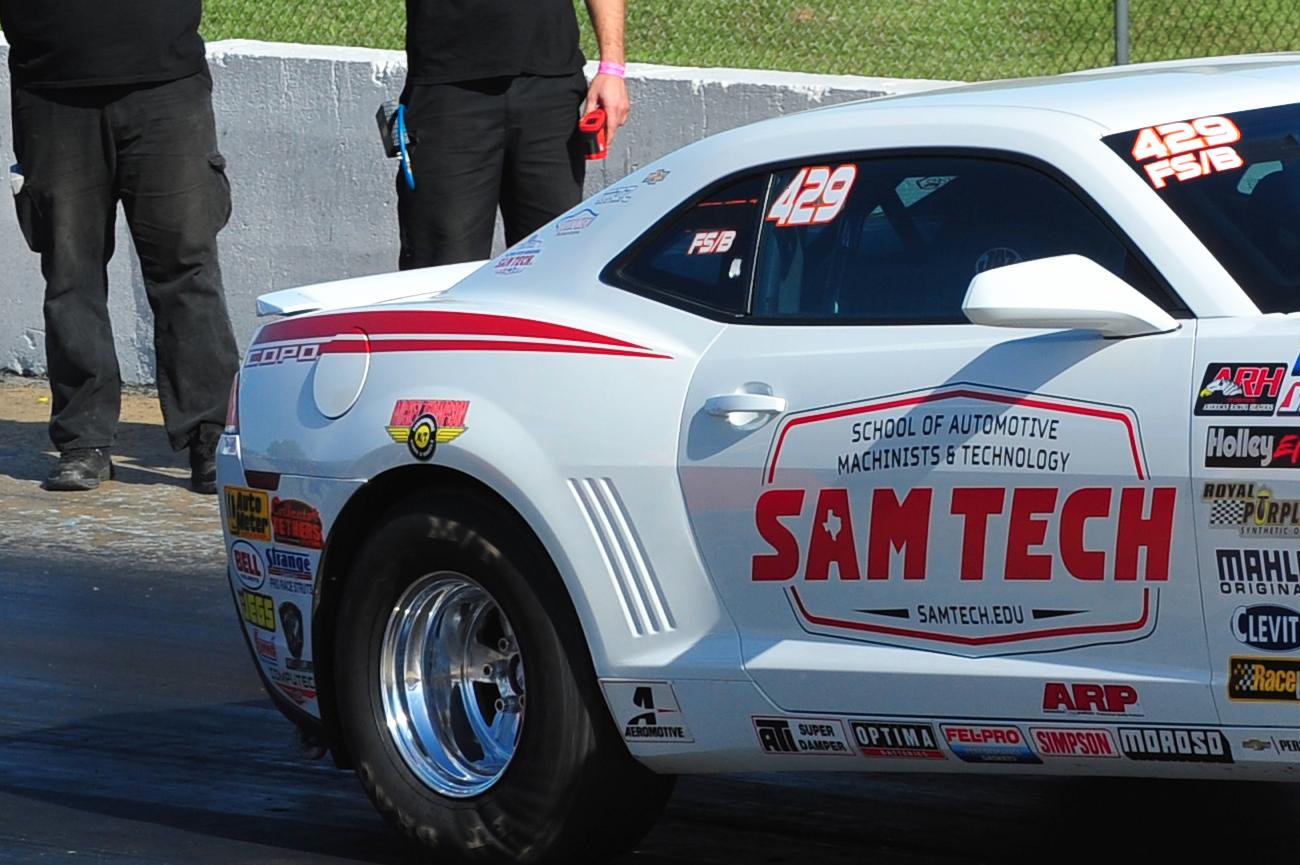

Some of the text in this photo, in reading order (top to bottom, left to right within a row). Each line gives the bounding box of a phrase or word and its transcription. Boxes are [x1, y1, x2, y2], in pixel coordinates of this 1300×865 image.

[1132, 115, 1242, 162] 429
[1143, 146, 1245, 189] FS/B
[767, 164, 858, 227] 429
[687, 230, 737, 255] FS/B
[245, 344, 320, 368] COPO
[1212, 366, 1284, 398] ARH
[851, 415, 1060, 443] SCHOOL OF AUTOMOTIVE
[837, 445, 1071, 475] MACHINISTS & TECHNOLOGY
[1207, 427, 1274, 466] Holley
[1203, 483, 1255, 498] ROYAL
[751, 486, 1177, 582] SAM TECH
[1240, 526, 1288, 536] SYNTHETIC
[234, 549, 261, 577] BELL
[266, 547, 312, 574] Strange
[917, 604, 1025, 626] SAMTECH.EDU
[1043, 683, 1138, 712] ARP
[625, 726, 685, 738] AEROMOTIVE
[799, 724, 836, 737] SUPER
[855, 726, 935, 750] OPTIMA
[945, 728, 1020, 744] FEL-PRO
[1036, 731, 1112, 755] SIMPSON
[1120, 729, 1224, 756] MOROSO
[799, 739, 848, 752] DAMPER
